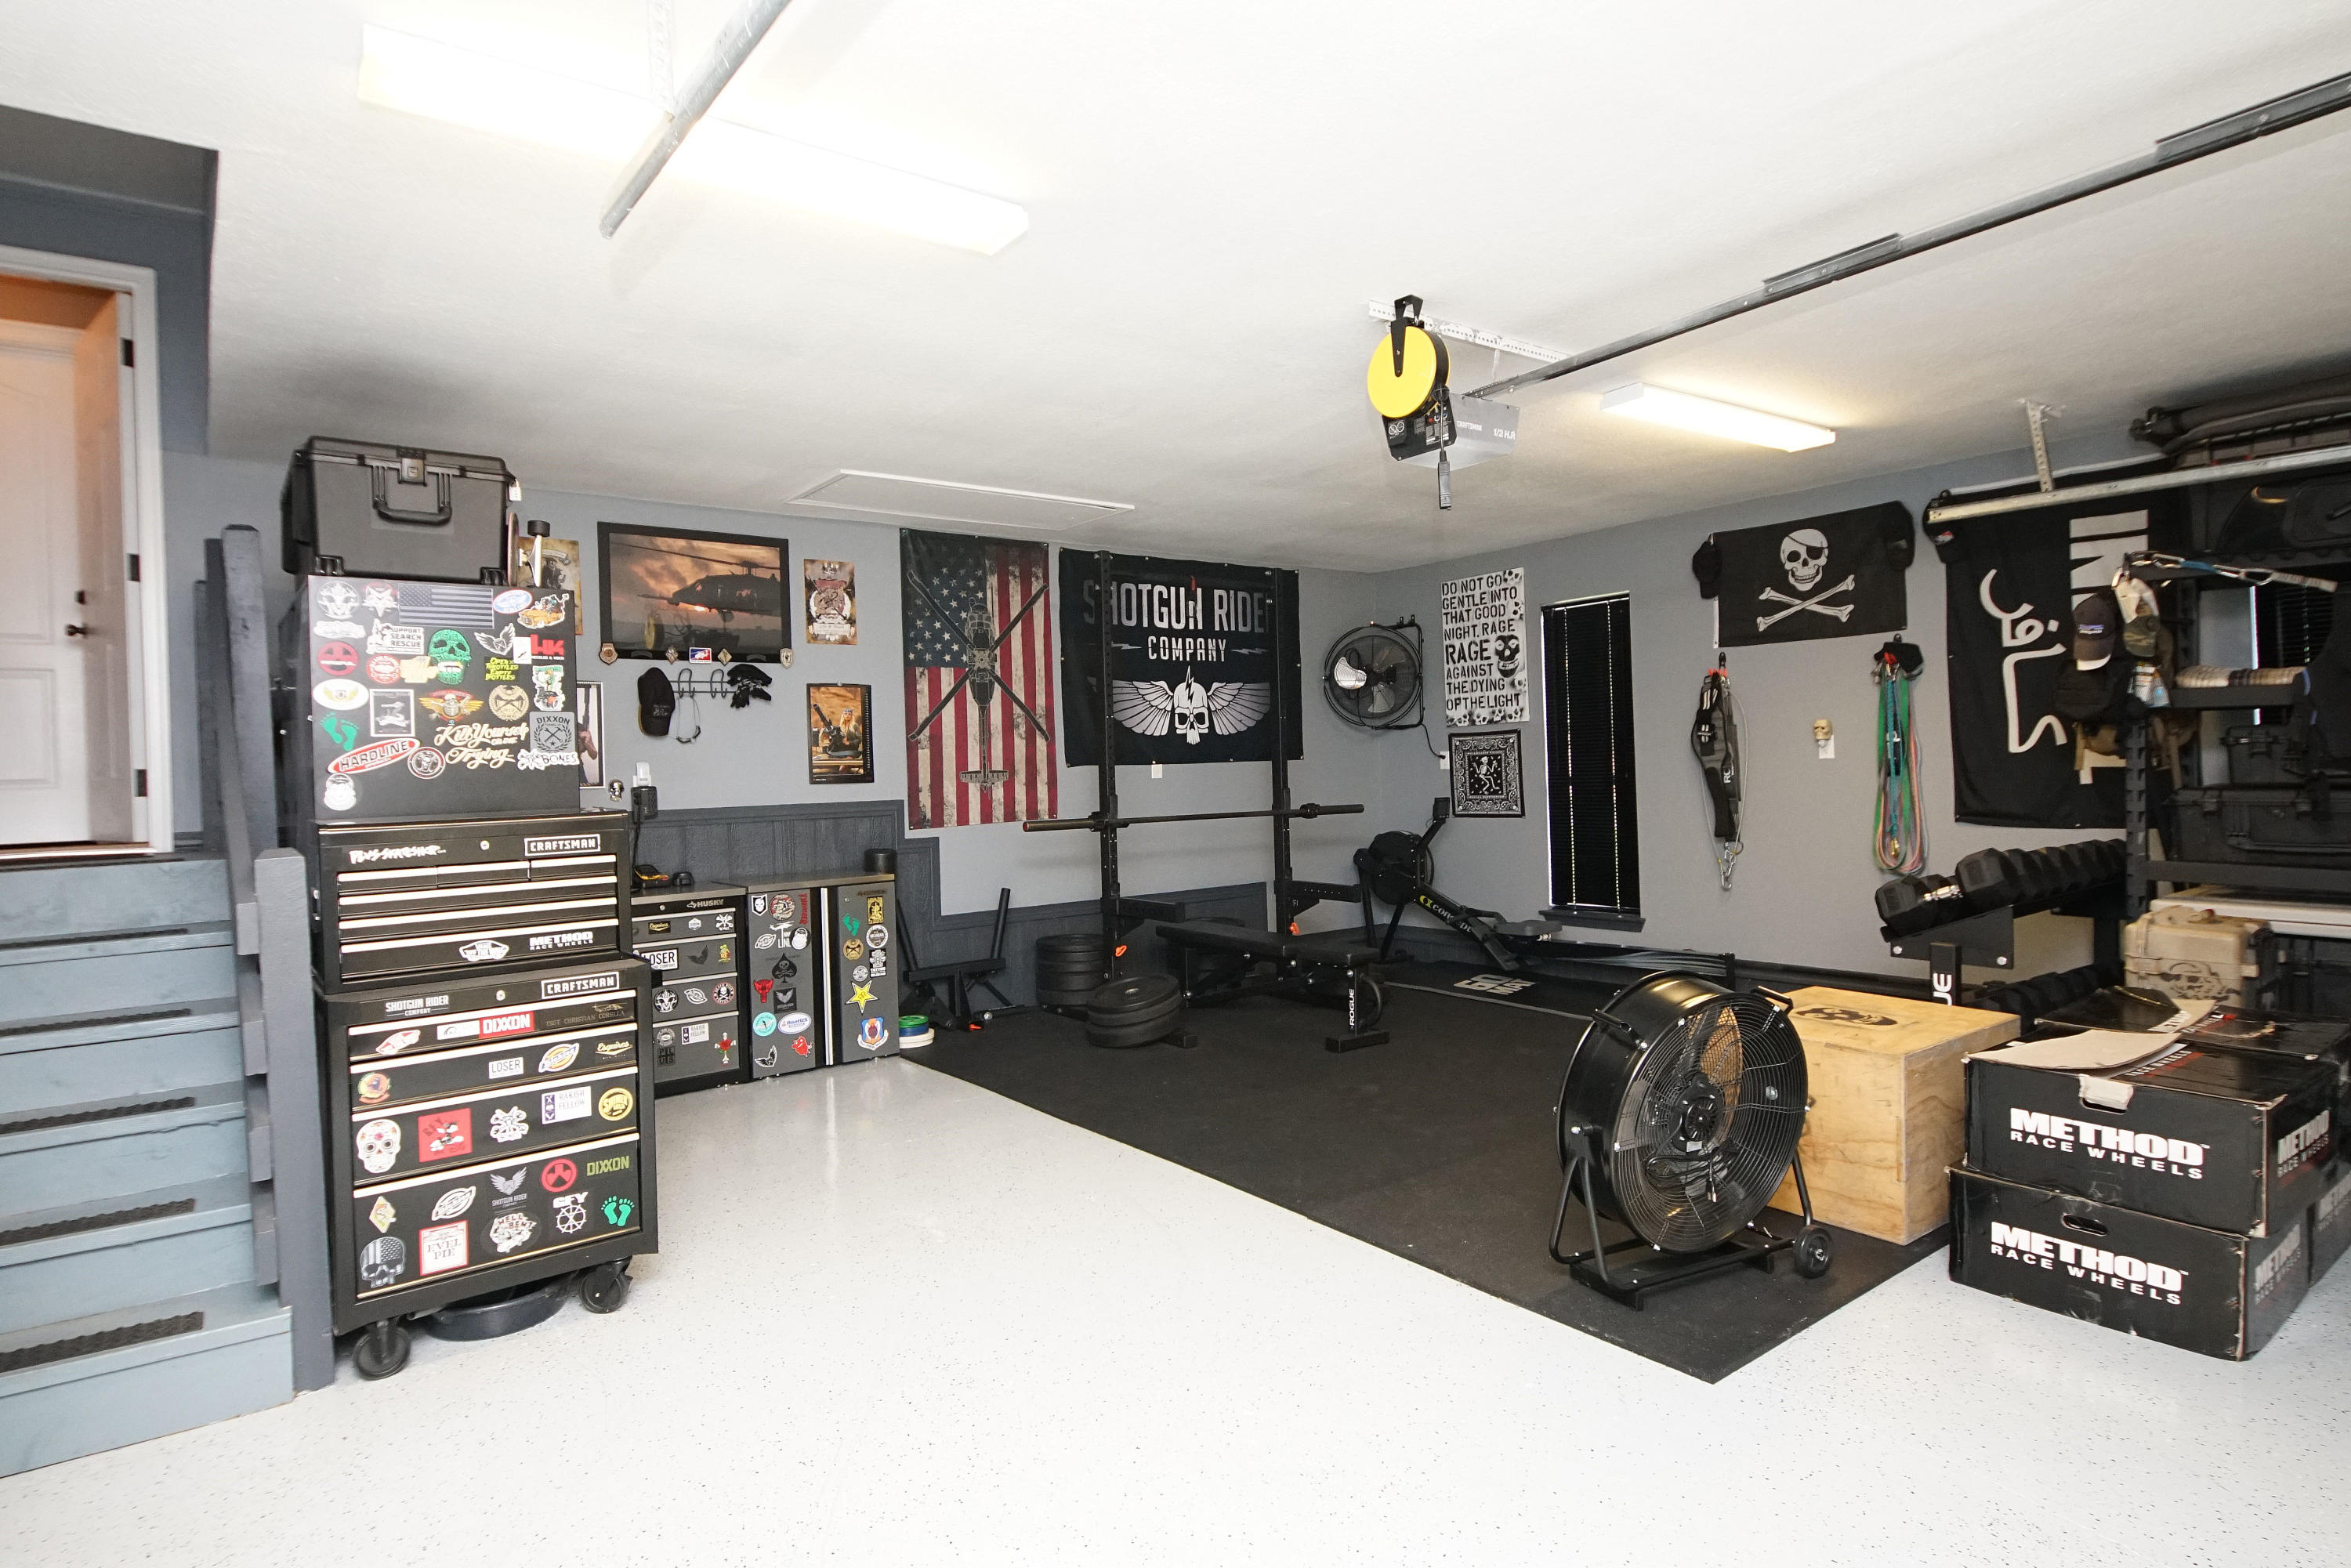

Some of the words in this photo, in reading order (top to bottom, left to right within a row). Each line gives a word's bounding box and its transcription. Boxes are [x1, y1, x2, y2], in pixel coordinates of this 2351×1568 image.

[1442, 582, 1458, 596] DO
[1460, 577, 1483, 593] NOT
[1486, 574, 1502, 588] GO
[1442, 591, 1487, 610] GENTLE
[1491, 585, 1518, 603] INTO
[1213, 588, 1268, 633] RIDE
[1443, 608, 1472, 625] THAT
[1474, 603, 1506, 620] GOOD
[1444, 624, 1480, 642] NIGHT.
[1481, 618, 1516, 636] RAGE
[1147, 636, 1227, 662] COMPANY
[1445, 639, 1492, 665] RAGE
[1446, 663, 1494, 680] AGAINST
[1446, 680, 1469, 695] THE
[1470, 677, 1505, 693] DYING
[1462, 695, 1486, 710] THE
[1487, 693, 1521, 708] LIGHT
[536, 715, 571, 726] DIXXON
[339, 740, 409, 772] HARDLINE
[445, 747, 516, 770] Trying
[530, 838, 596, 852] CRAFTSMAN
[697, 899, 724, 908] HUSKY
[529, 931, 594, 947] METHOD
[556, 939, 594, 947] WHEELS
[547, 976, 614, 994] CRAFTSMAN
[1486, 979, 1538, 995] MAT
[385, 998, 425, 1012] SHOTGUN
[425, 994, 450, 1007] RIDER
[404, 1007, 432, 1017] COMPANY
[482, 1013, 531, 1034] DIXXON
[563, 1014, 596, 1024] CHRISTIAN
[598, 1010, 625, 1019] CORELLA
[491, 1059, 520, 1073] LOSER
[559, 1090, 585, 1099] RAKISH
[559, 1099, 585, 1110] FELLOW
[2010, 1107, 2204, 1167] METHOD
[2277, 1110, 2331, 1165] METHOD
[2010, 1130, 2074, 1153] RACE
[2086, 1146, 2203, 1180] WHEELS
[586, 1155, 629, 1176] DIXXON
[491, 1195, 513, 1207] SHOTGUN
[513, 1193, 527, 1202] RIDER
[427, 1238, 462, 1253] EVEL
[434, 1248, 456, 1260] PIE
[1991, 1221, 2183, 1292] METHOD
[1991, 1244, 2054, 1270] RACE
[2067, 1264, 2182, 1305] WHEELS
